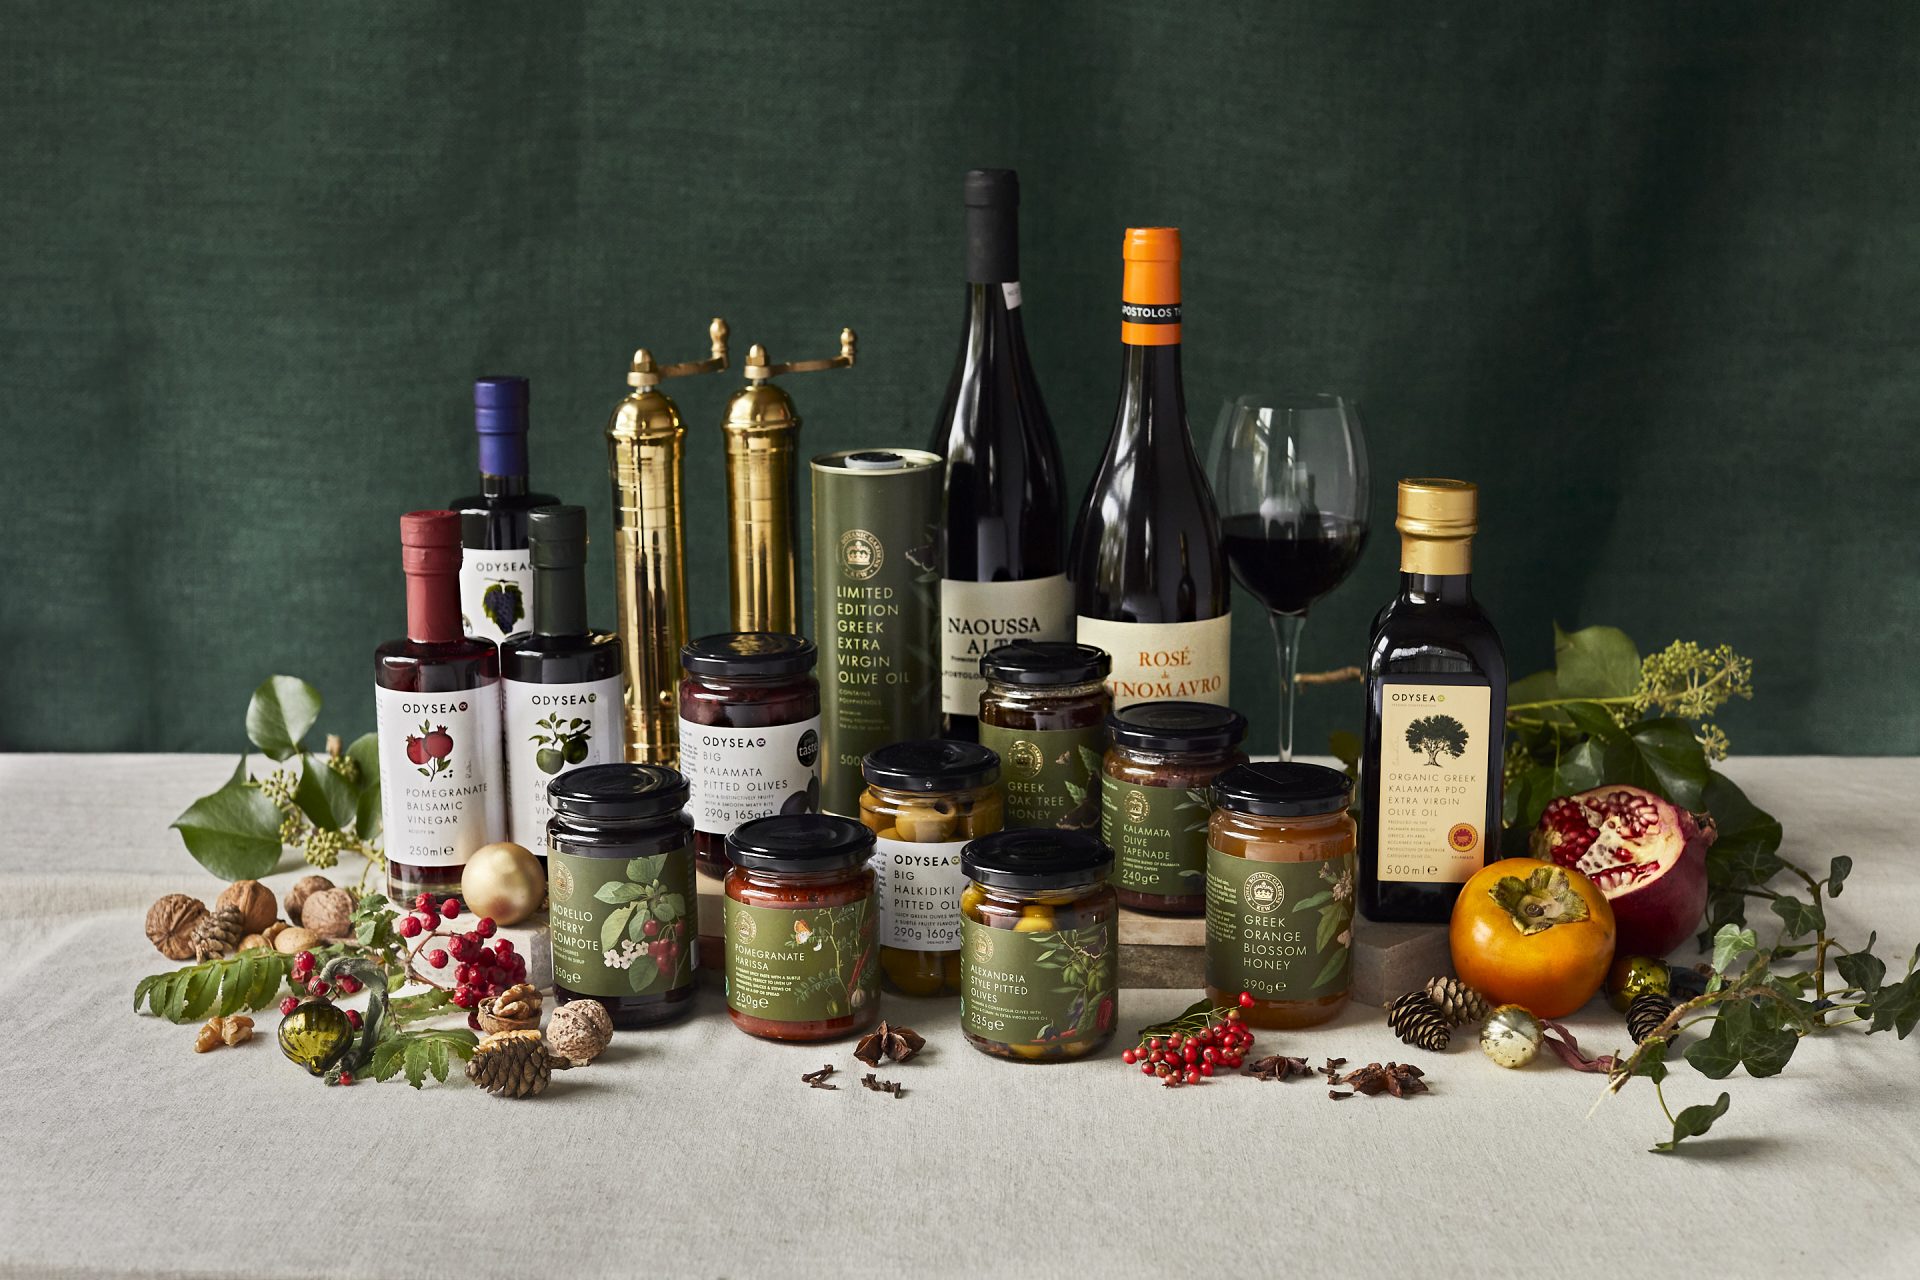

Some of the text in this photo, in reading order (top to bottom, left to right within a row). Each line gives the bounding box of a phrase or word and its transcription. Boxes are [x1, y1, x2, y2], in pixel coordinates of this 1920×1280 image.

[476, 562, 527, 572] ODYSEA
[837, 586, 893, 599] LIMITED
[837, 602, 899, 616] EDITION
[837, 619, 884, 633] GREEK
[948, 617, 1041, 635] NAOUSSA
[837, 636, 880, 650] EXTRA
[967, 638, 1009, 655] ALT
[837, 654, 890, 668] VIRGIN
[1139, 646, 1191, 668] ROSÉ
[838, 671, 909, 684] OLIVE OIL
[1112, 675, 1221, 698] INOMAVRO
[531, 695, 587, 705] ODYSEA
[1392, 693, 1436, 702] ODYSEA
[402, 703, 458, 714] ODYSEA
[703, 736, 754, 748] ODYSEA
[703, 752, 721, 762] BIG
[840, 754, 861, 766] 500
[703, 766, 762, 777] KALAMATA
[1389, 773, 1476, 782] ORGANIC GREEK
[406, 783, 488, 798] POMEGRANATE
[703, 780, 788, 791] PITTED OLIVES
[1008, 781, 1045, 793] GREEK
[1388, 785, 1466, 794] KALAMATA PDO
[407, 801, 463, 811] BALSAMIC
[1008, 795, 1064, 806] OAK TREE
[1388, 796, 1460, 806] EXTRA VIRGIN
[705, 808, 730, 822] 290g
[1008, 809, 1051, 820] HONEY
[1388, 808, 1438, 816] OLIVE OIL
[407, 815, 458, 824] VINEGAR
[1123, 824, 1171, 838] KALAMATA
[1123, 835, 1148, 847] OLIVE
[1123, 846, 1170, 860] TAPENADE
[894, 854, 949, 866] ODYSEA
[894, 870, 915, 880] BIG
[1122, 868, 1148, 885] 240g
[894, 885, 955, 896] HALKIDIKI
[894, 899, 960, 910] PITTED OLI
[552, 901, 592, 922] MORELLO
[552, 916, 584, 935] CHERRY
[1244, 914, 1286, 927] GREEK
[894, 926, 954, 940] 290g 160g
[1243, 929, 1301, 942] ORANGE
[553, 930, 599, 951] COMPOTE
[735, 944, 805, 962] POMEGRANATE
[1243, 943, 1307, 956] BLOSSOM
[735, 955, 769, 971] HARISSA
[1243, 957, 1291, 970] HONEY
[970, 964, 1026, 984] ALEXANDRIA
[970, 975, 1028, 996] STYLE PITTED
[1243, 978, 1273, 994] 390g
[736, 991, 758, 1008] 250g
[970, 988, 998, 1004] OLIVES
[971, 1012, 993, 1030] 235g
